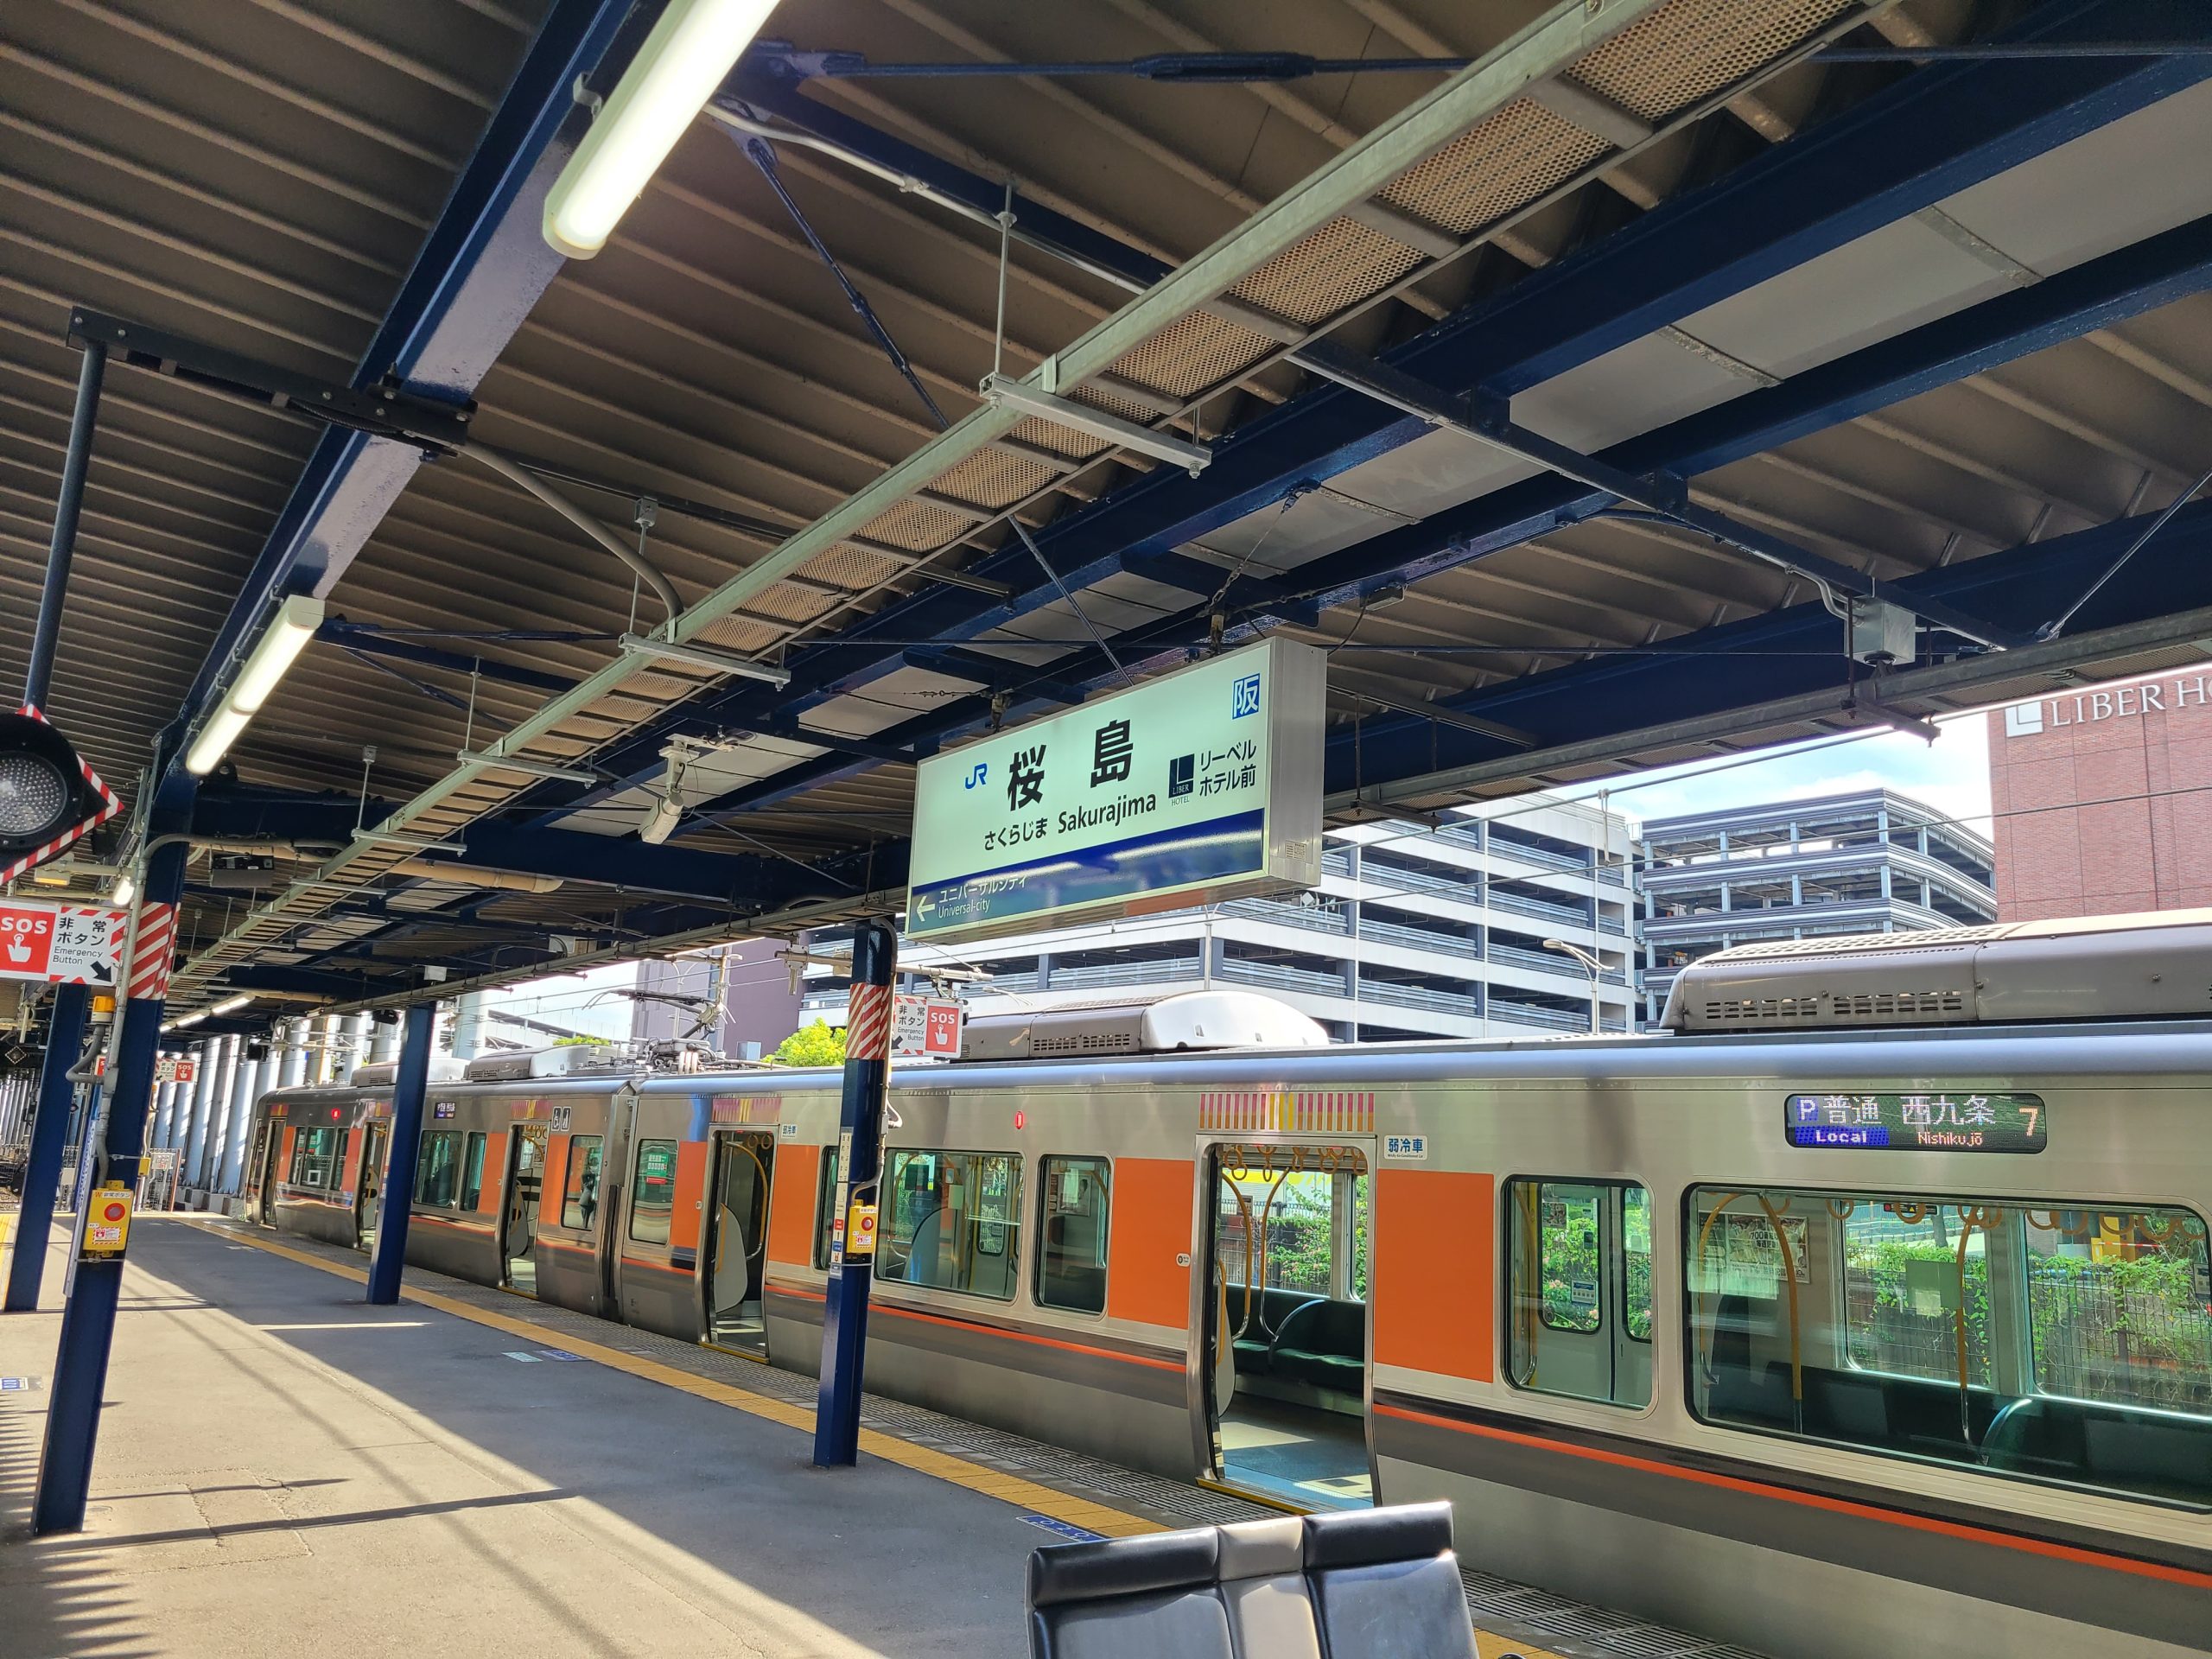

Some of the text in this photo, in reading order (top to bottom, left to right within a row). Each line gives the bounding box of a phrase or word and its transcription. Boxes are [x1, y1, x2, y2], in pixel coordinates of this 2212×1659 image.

[1234, 677, 1260, 718] 阪
[2050, 684, 2166, 727] LIBER
[1007, 719, 1134, 812] 桜島
[1199, 739, 1257, 772] リーベル
[963, 763, 988, 790] JR
[1199, 764, 1256, 798] ホテル前
[1171, 795, 1190, 806] HOTEL
[1172, 785, 1190, 795] LIBER
[1057, 793, 1157, 835] Sakurajima
[983, 817, 1048, 851] さくらじま
[938, 875, 1027, 904] ユニバーサルシティ
[938, 898, 990, 918] Universal-city
[0, 916, 48, 934] SOS
[59, 917, 107, 933] 非常
[57, 931, 105, 946] ボタン
[53, 955, 83, 965] Button
[54, 946, 103, 958] Emergency
[899, 1005, 925, 1016] 非常
[931, 1012, 955, 1024] SOS
[899, 1016, 925, 1027] ボタン
[1799, 1099, 1815, 1122] P
[1823, 1095, 1882, 1124] 普通
[1900, 1095, 1996, 1126] 西九条
[2018, 1108, 2039, 1136] 7
[1388, 1138, 1423, 1153] 弱冷車
[1816, 1130, 1867, 1143] Local
